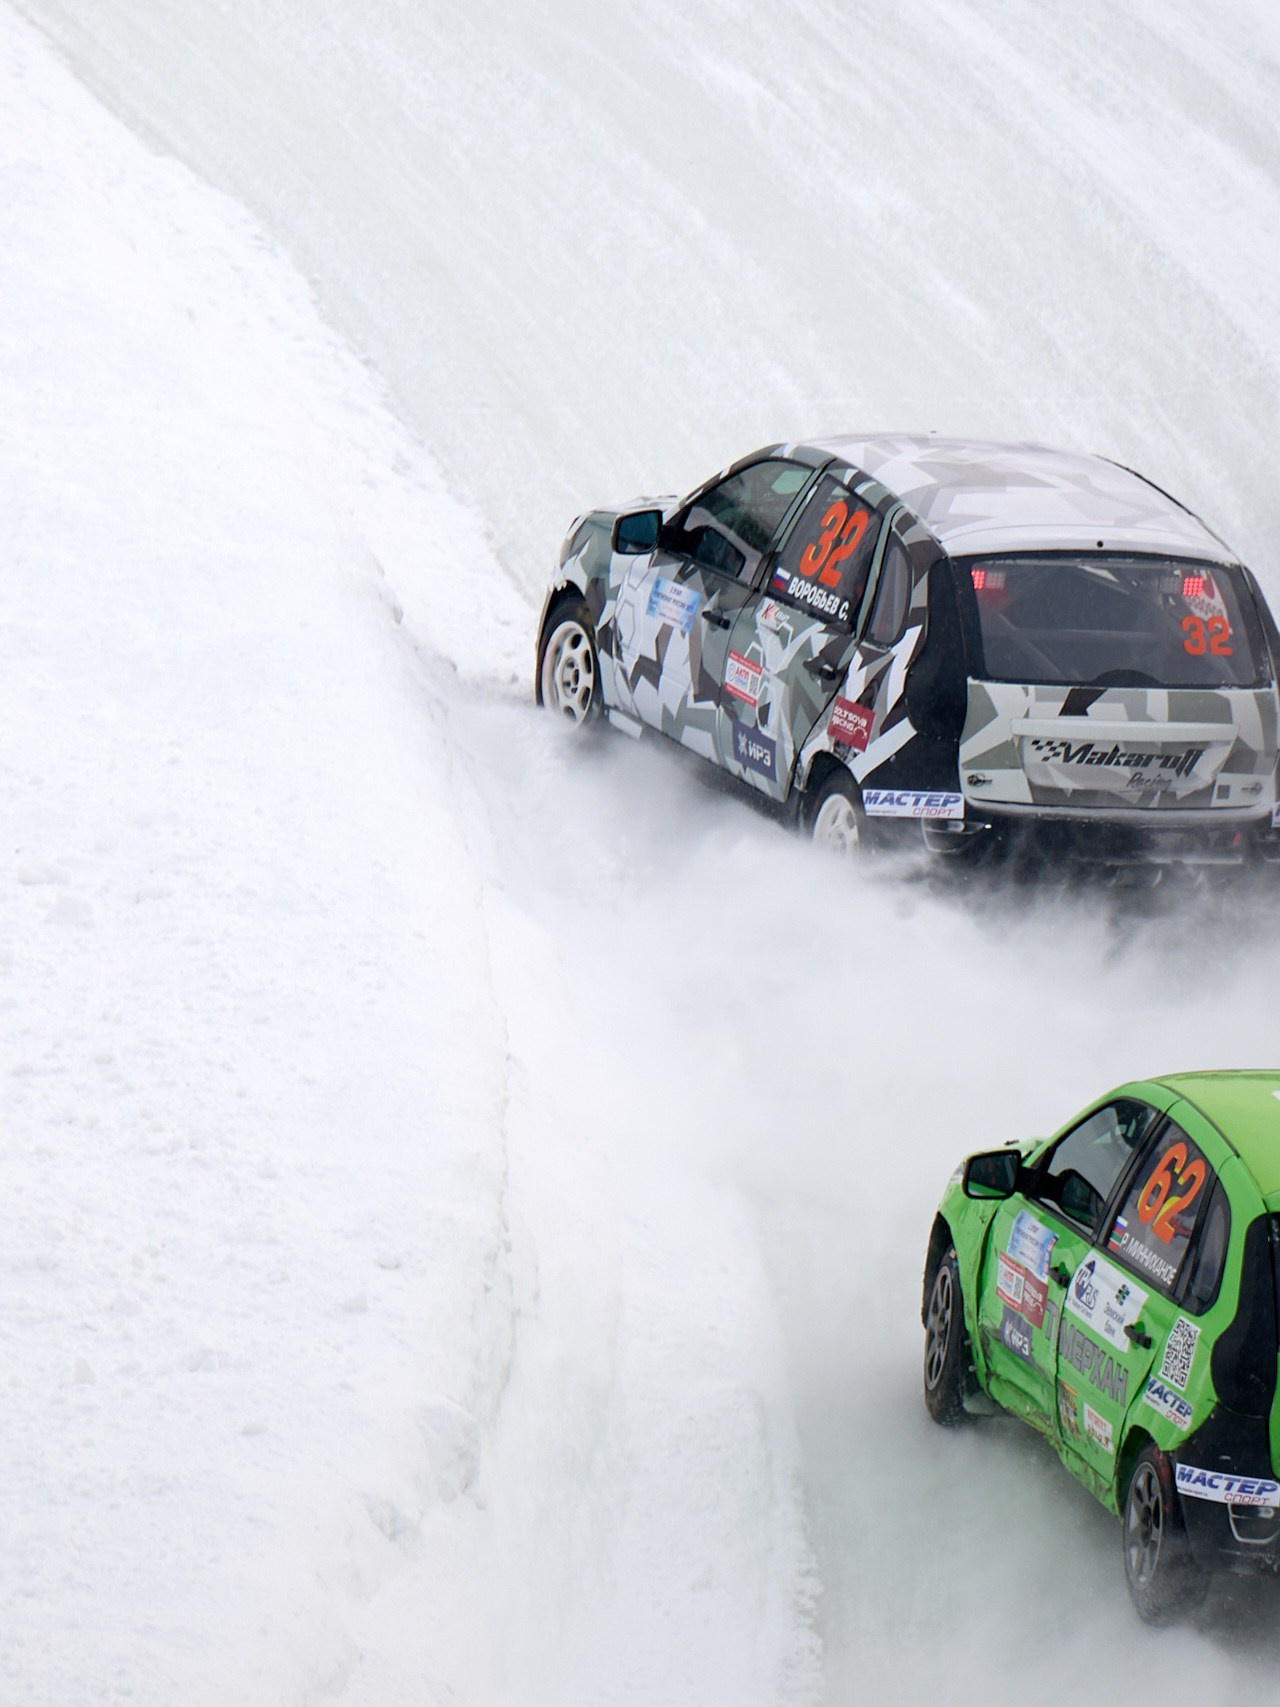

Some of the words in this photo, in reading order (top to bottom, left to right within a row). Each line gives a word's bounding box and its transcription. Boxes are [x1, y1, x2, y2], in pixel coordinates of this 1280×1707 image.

[798, 501, 870, 589] 32
[787, 577, 840, 615] ВОРОБЬЕВ
[838, 601, 849, 621] С.
[1182, 615, 1233, 656] 32
[748, 740, 772, 767] ИРЗ
[864, 791, 961, 808] МАСТЕР
[912, 807, 954, 817] СПОРТ
[1137, 1142, 1206, 1245] 62
[1165, 1410, 1188, 1430] СПОРТ
[1177, 1466, 1278, 1496] МАСТЕР
[1223, 1492, 1270, 1506] СПОРТ
